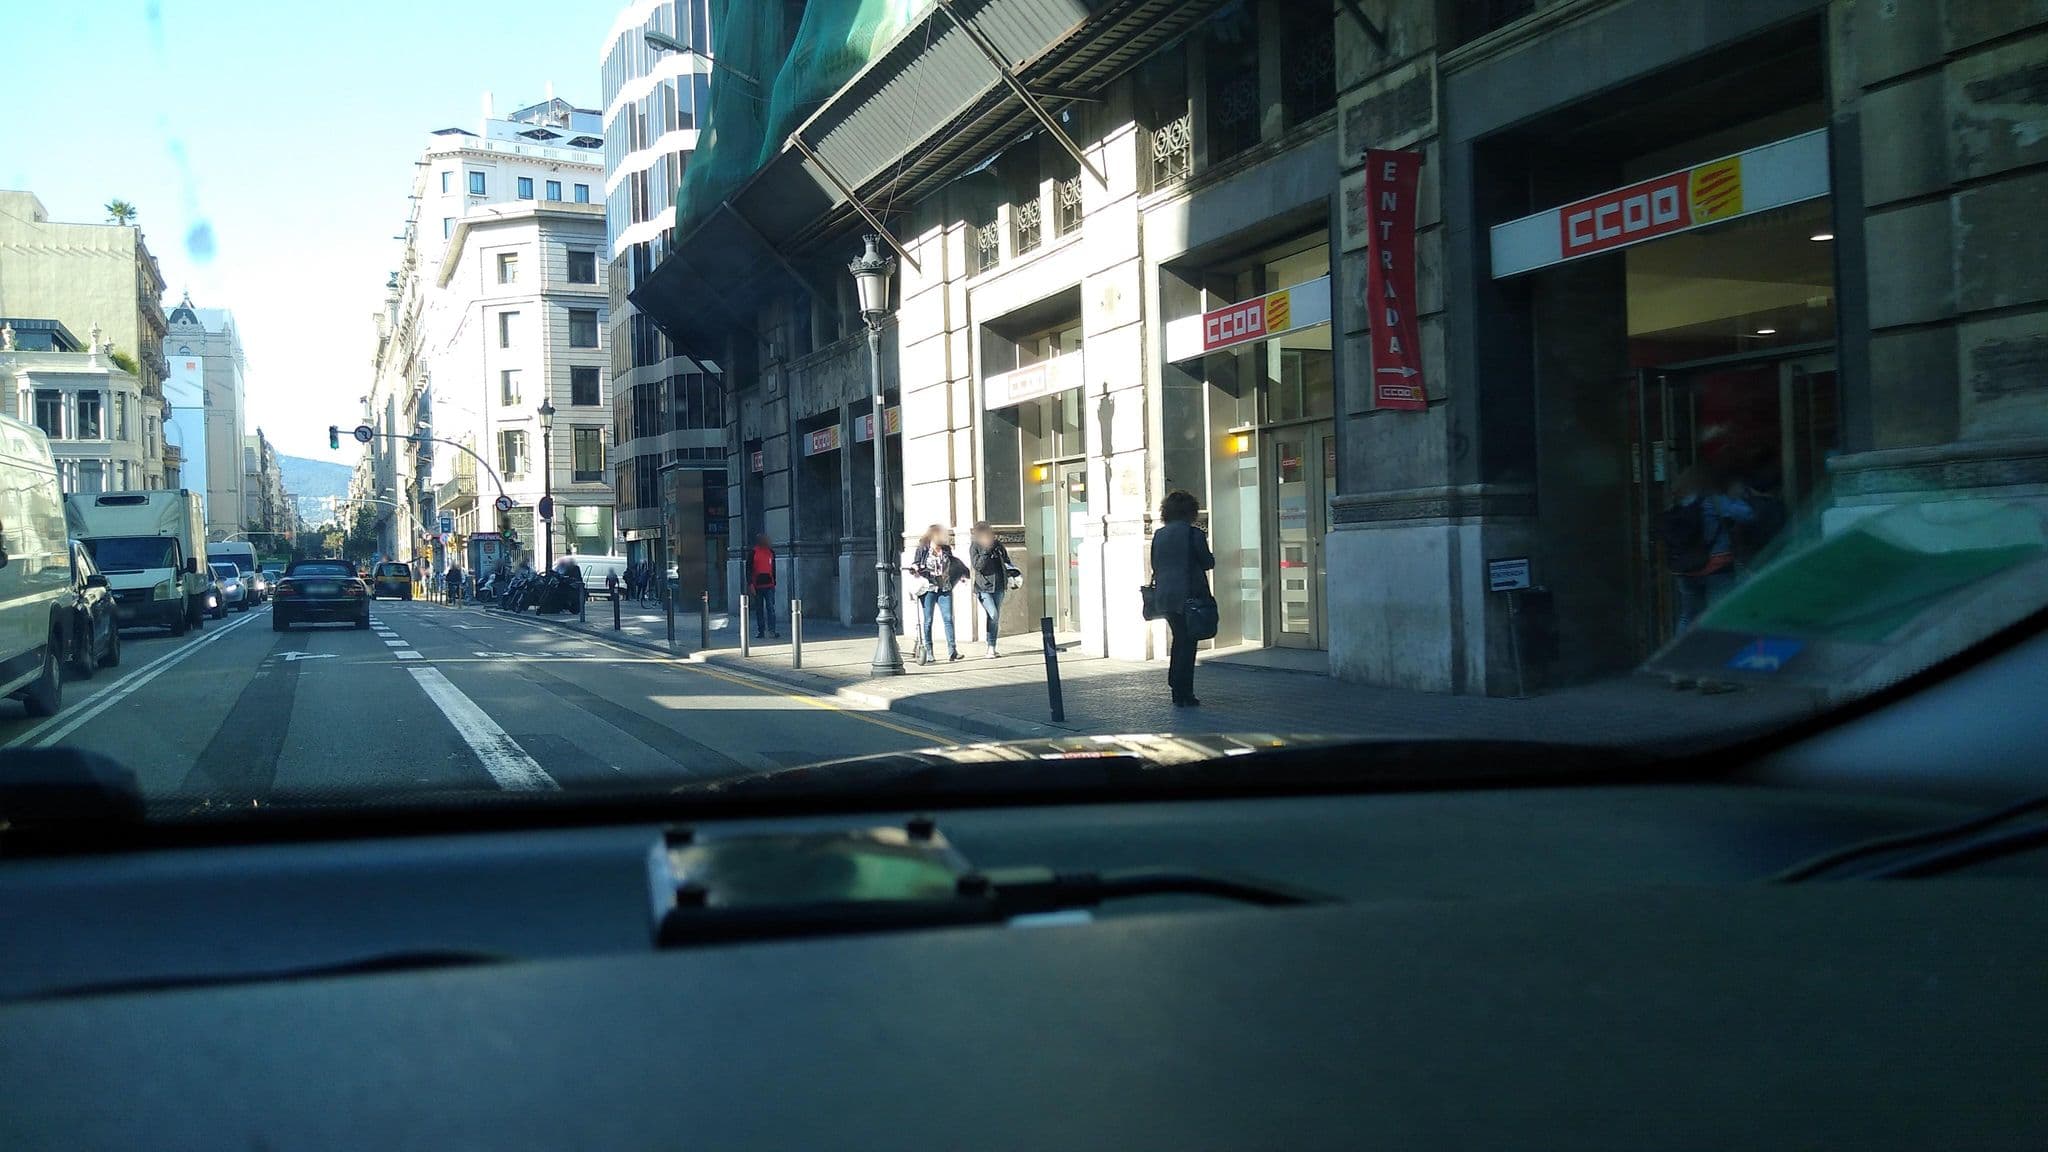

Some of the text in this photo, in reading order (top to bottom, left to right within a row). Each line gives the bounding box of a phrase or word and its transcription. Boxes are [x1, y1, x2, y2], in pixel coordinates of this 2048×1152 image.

[1568, 185, 1680, 248] CCOO
[1380, 161, 1402, 354] ENTRADA
[1206, 305, 1261, 344] CCOO
[1383, 388, 1411, 397] CCOO
